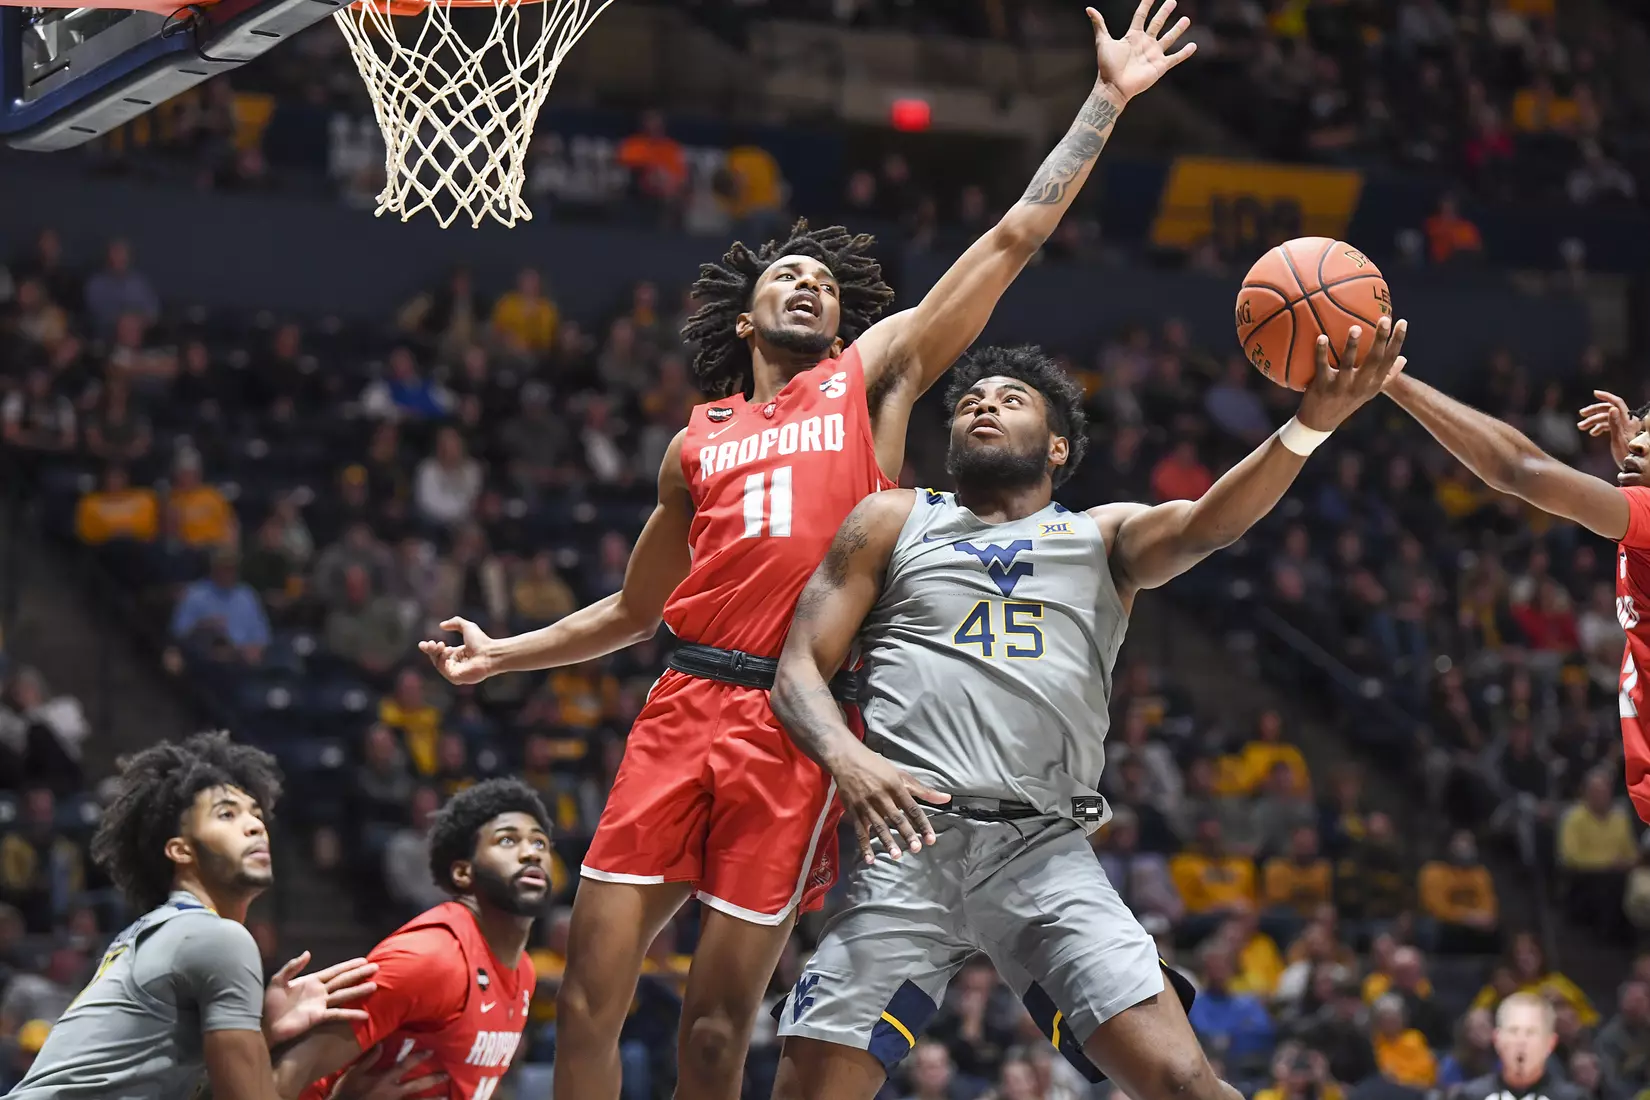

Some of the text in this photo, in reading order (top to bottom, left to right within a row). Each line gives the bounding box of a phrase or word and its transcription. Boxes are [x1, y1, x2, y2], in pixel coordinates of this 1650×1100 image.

[699, 413, 846, 482] RADFORD
[741, 465, 793, 539] 11
[1043, 523, 1067, 533] XII
[953, 600, 1046, 660] 45
